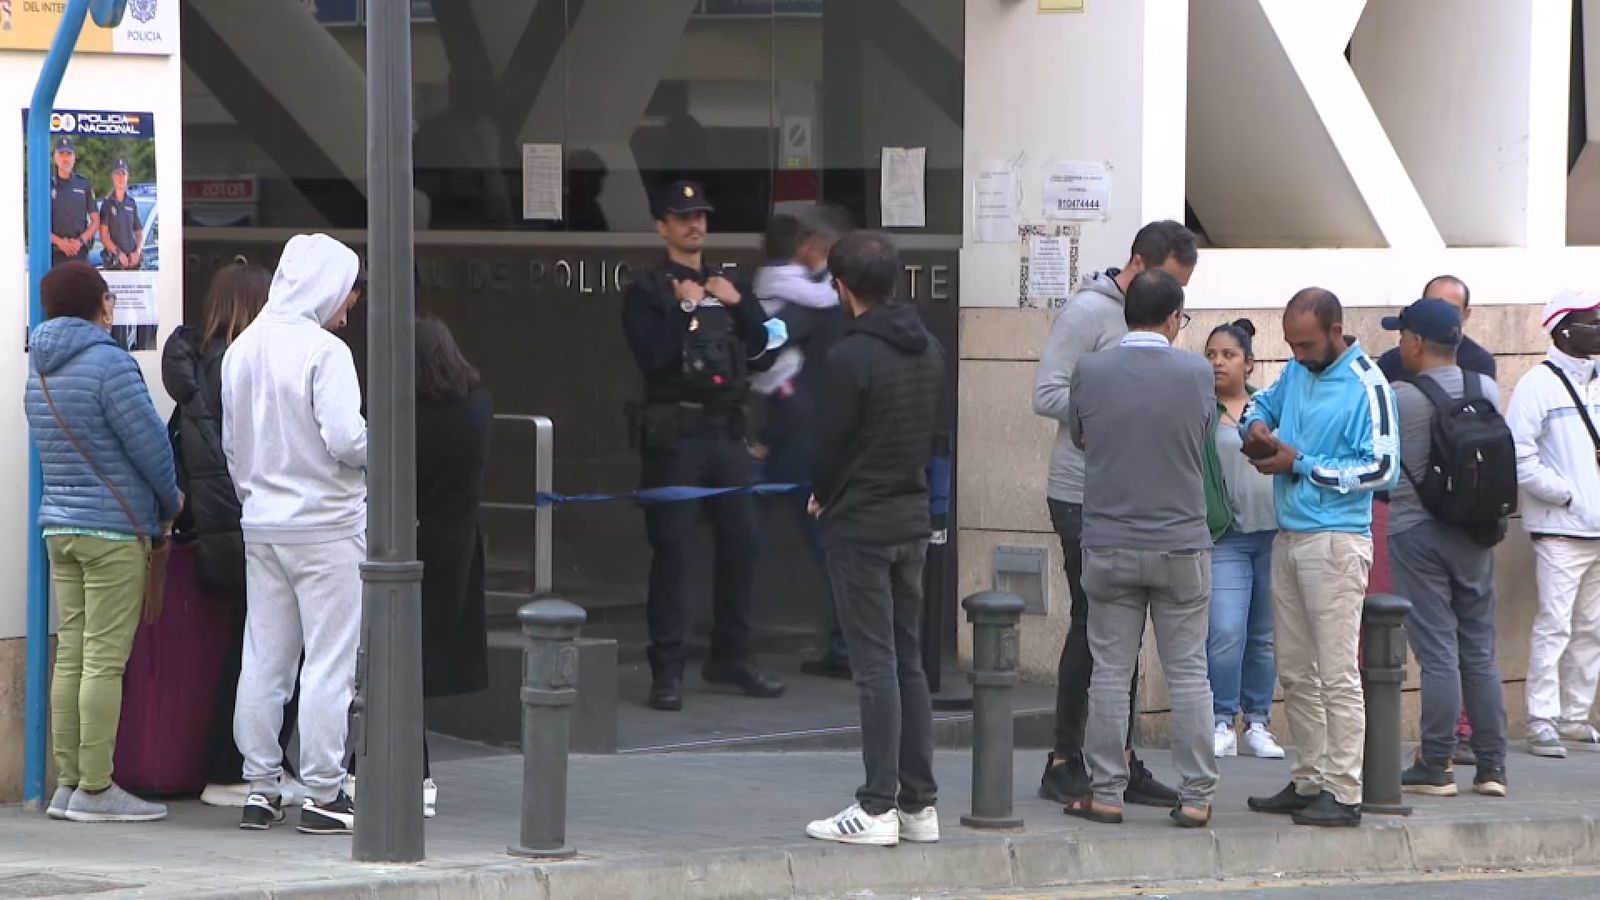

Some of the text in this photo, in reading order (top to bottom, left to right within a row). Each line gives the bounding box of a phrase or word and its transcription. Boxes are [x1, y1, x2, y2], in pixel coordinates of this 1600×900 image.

[23, 1, 66, 14] DEL INTER
[78, 113, 128, 123] POLICIA
[78, 124, 140, 134] NACIONAL
[528, 258, 634, 293] POLIC
